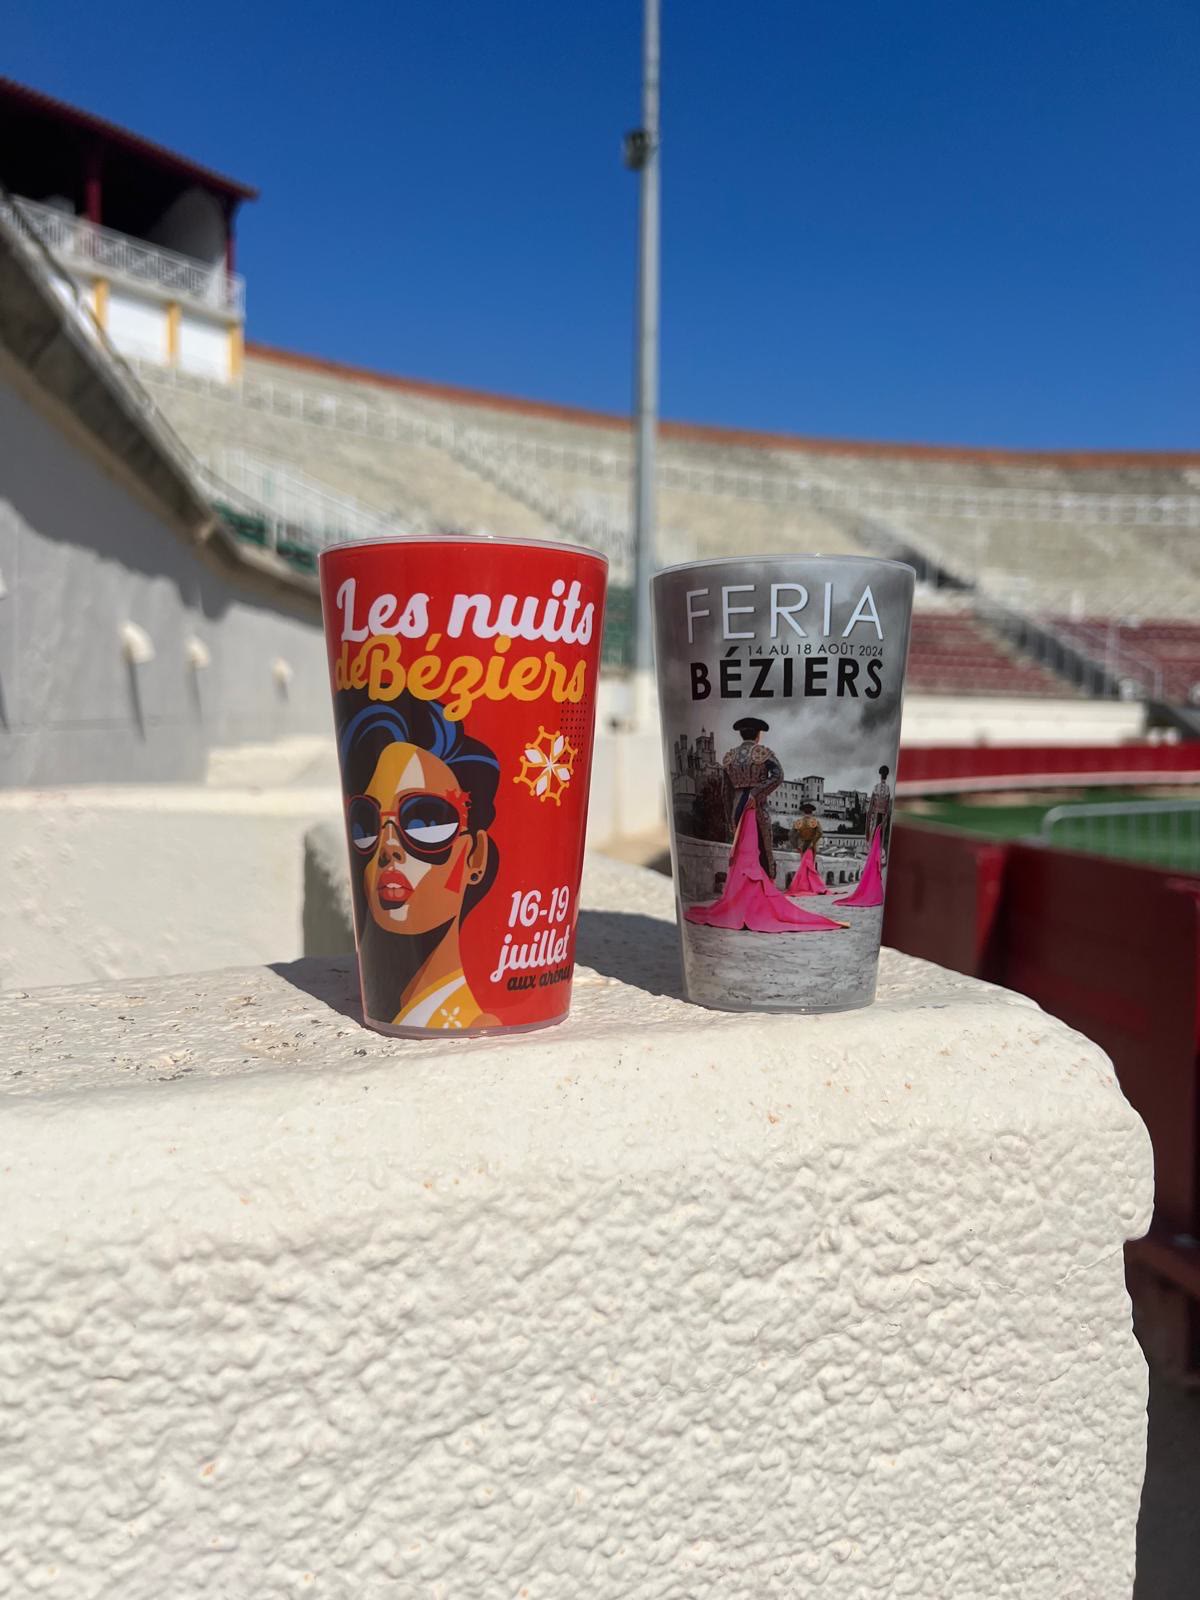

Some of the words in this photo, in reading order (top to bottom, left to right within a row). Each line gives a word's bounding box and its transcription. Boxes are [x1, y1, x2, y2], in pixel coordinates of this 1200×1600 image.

[336, 577, 430, 643] Les
[447, 579, 595, 646] nuits
[686, 582, 884, 644] FERIA
[335, 641, 369, 691] de
[361, 633, 586, 722] Béziers
[690, 646, 884, 700] BÉZIERS
[748, 645, 763, 657] 14
[769, 644, 789, 656] AU
[796, 643, 812, 656] 18
[817, 642, 855, 656] AOÛT
[859, 645, 883, 657] 2024
[508, 885, 570, 928] 16-19
[490, 924, 570, 983] juillet
[507, 975, 537, 991] aux
